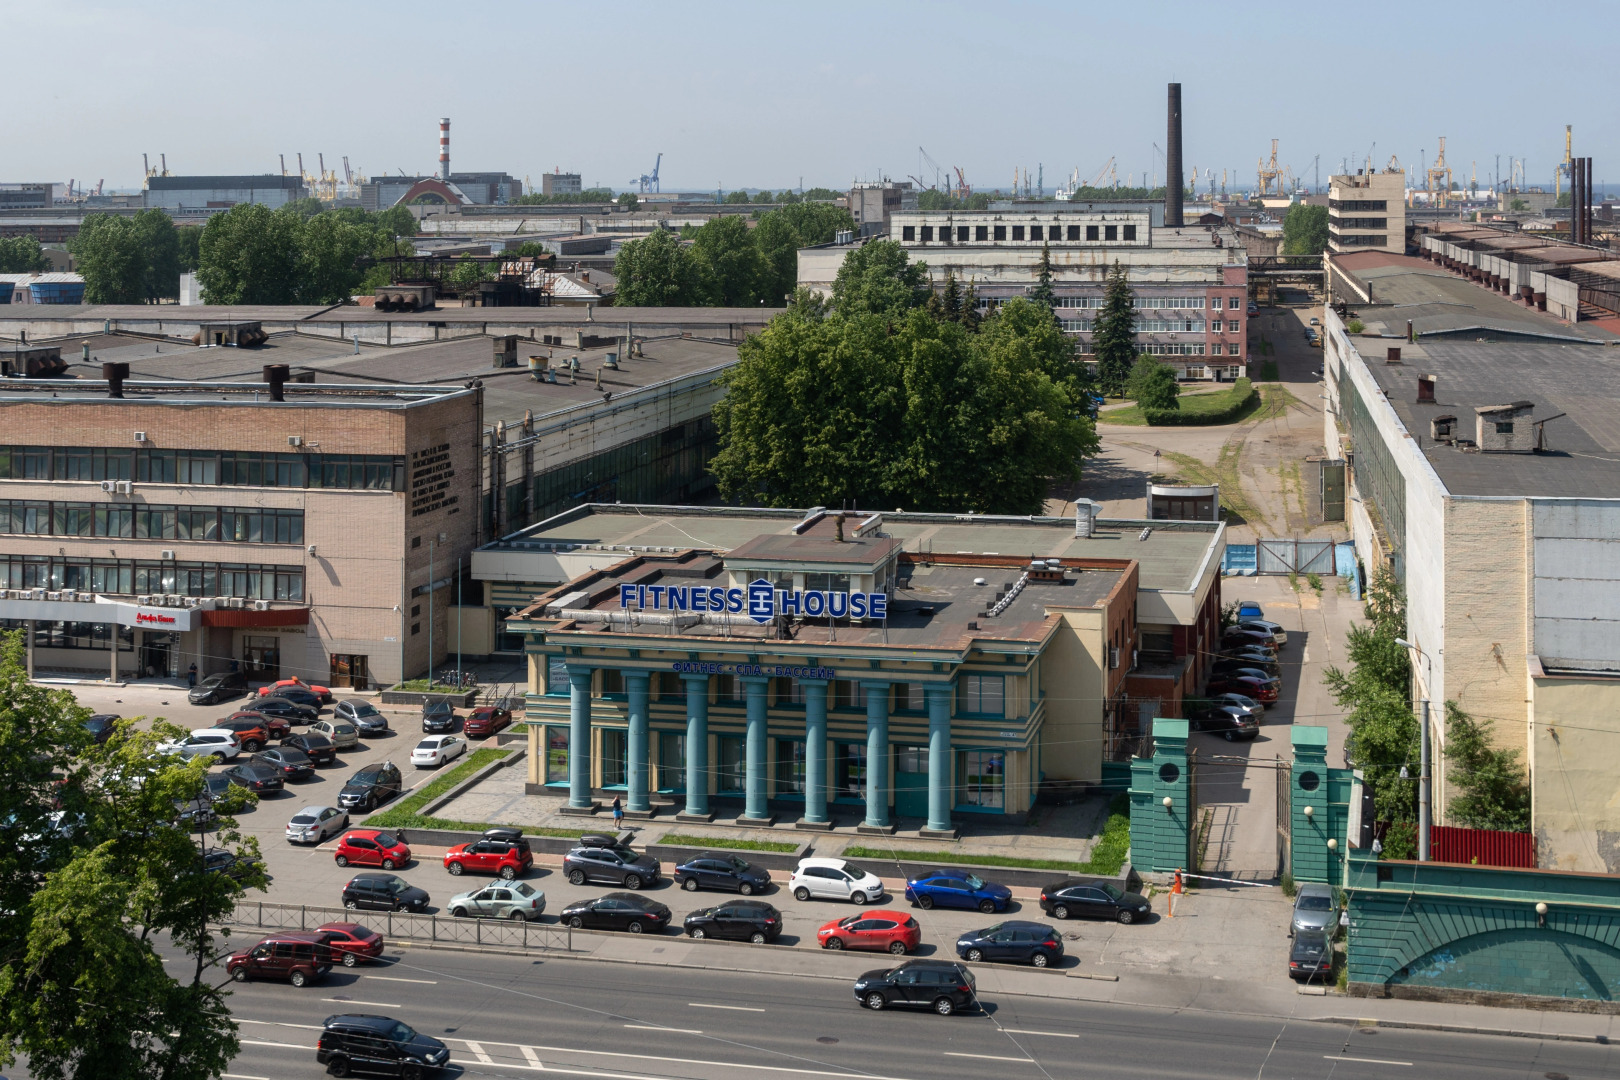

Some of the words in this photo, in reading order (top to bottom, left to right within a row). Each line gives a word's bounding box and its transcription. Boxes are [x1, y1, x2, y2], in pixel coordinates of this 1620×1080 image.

[621, 584, 744, 613] FITNESS
[780, 590, 887, 618] HOUSE
[136, 612, 157, 623] Альфа
[157, 614, 175, 623] Банк
[672, 662, 725, 674] ФИТНЕС
[736, 664, 762, 676] СПА
[775, 665, 835, 679] БАССЕЙН
